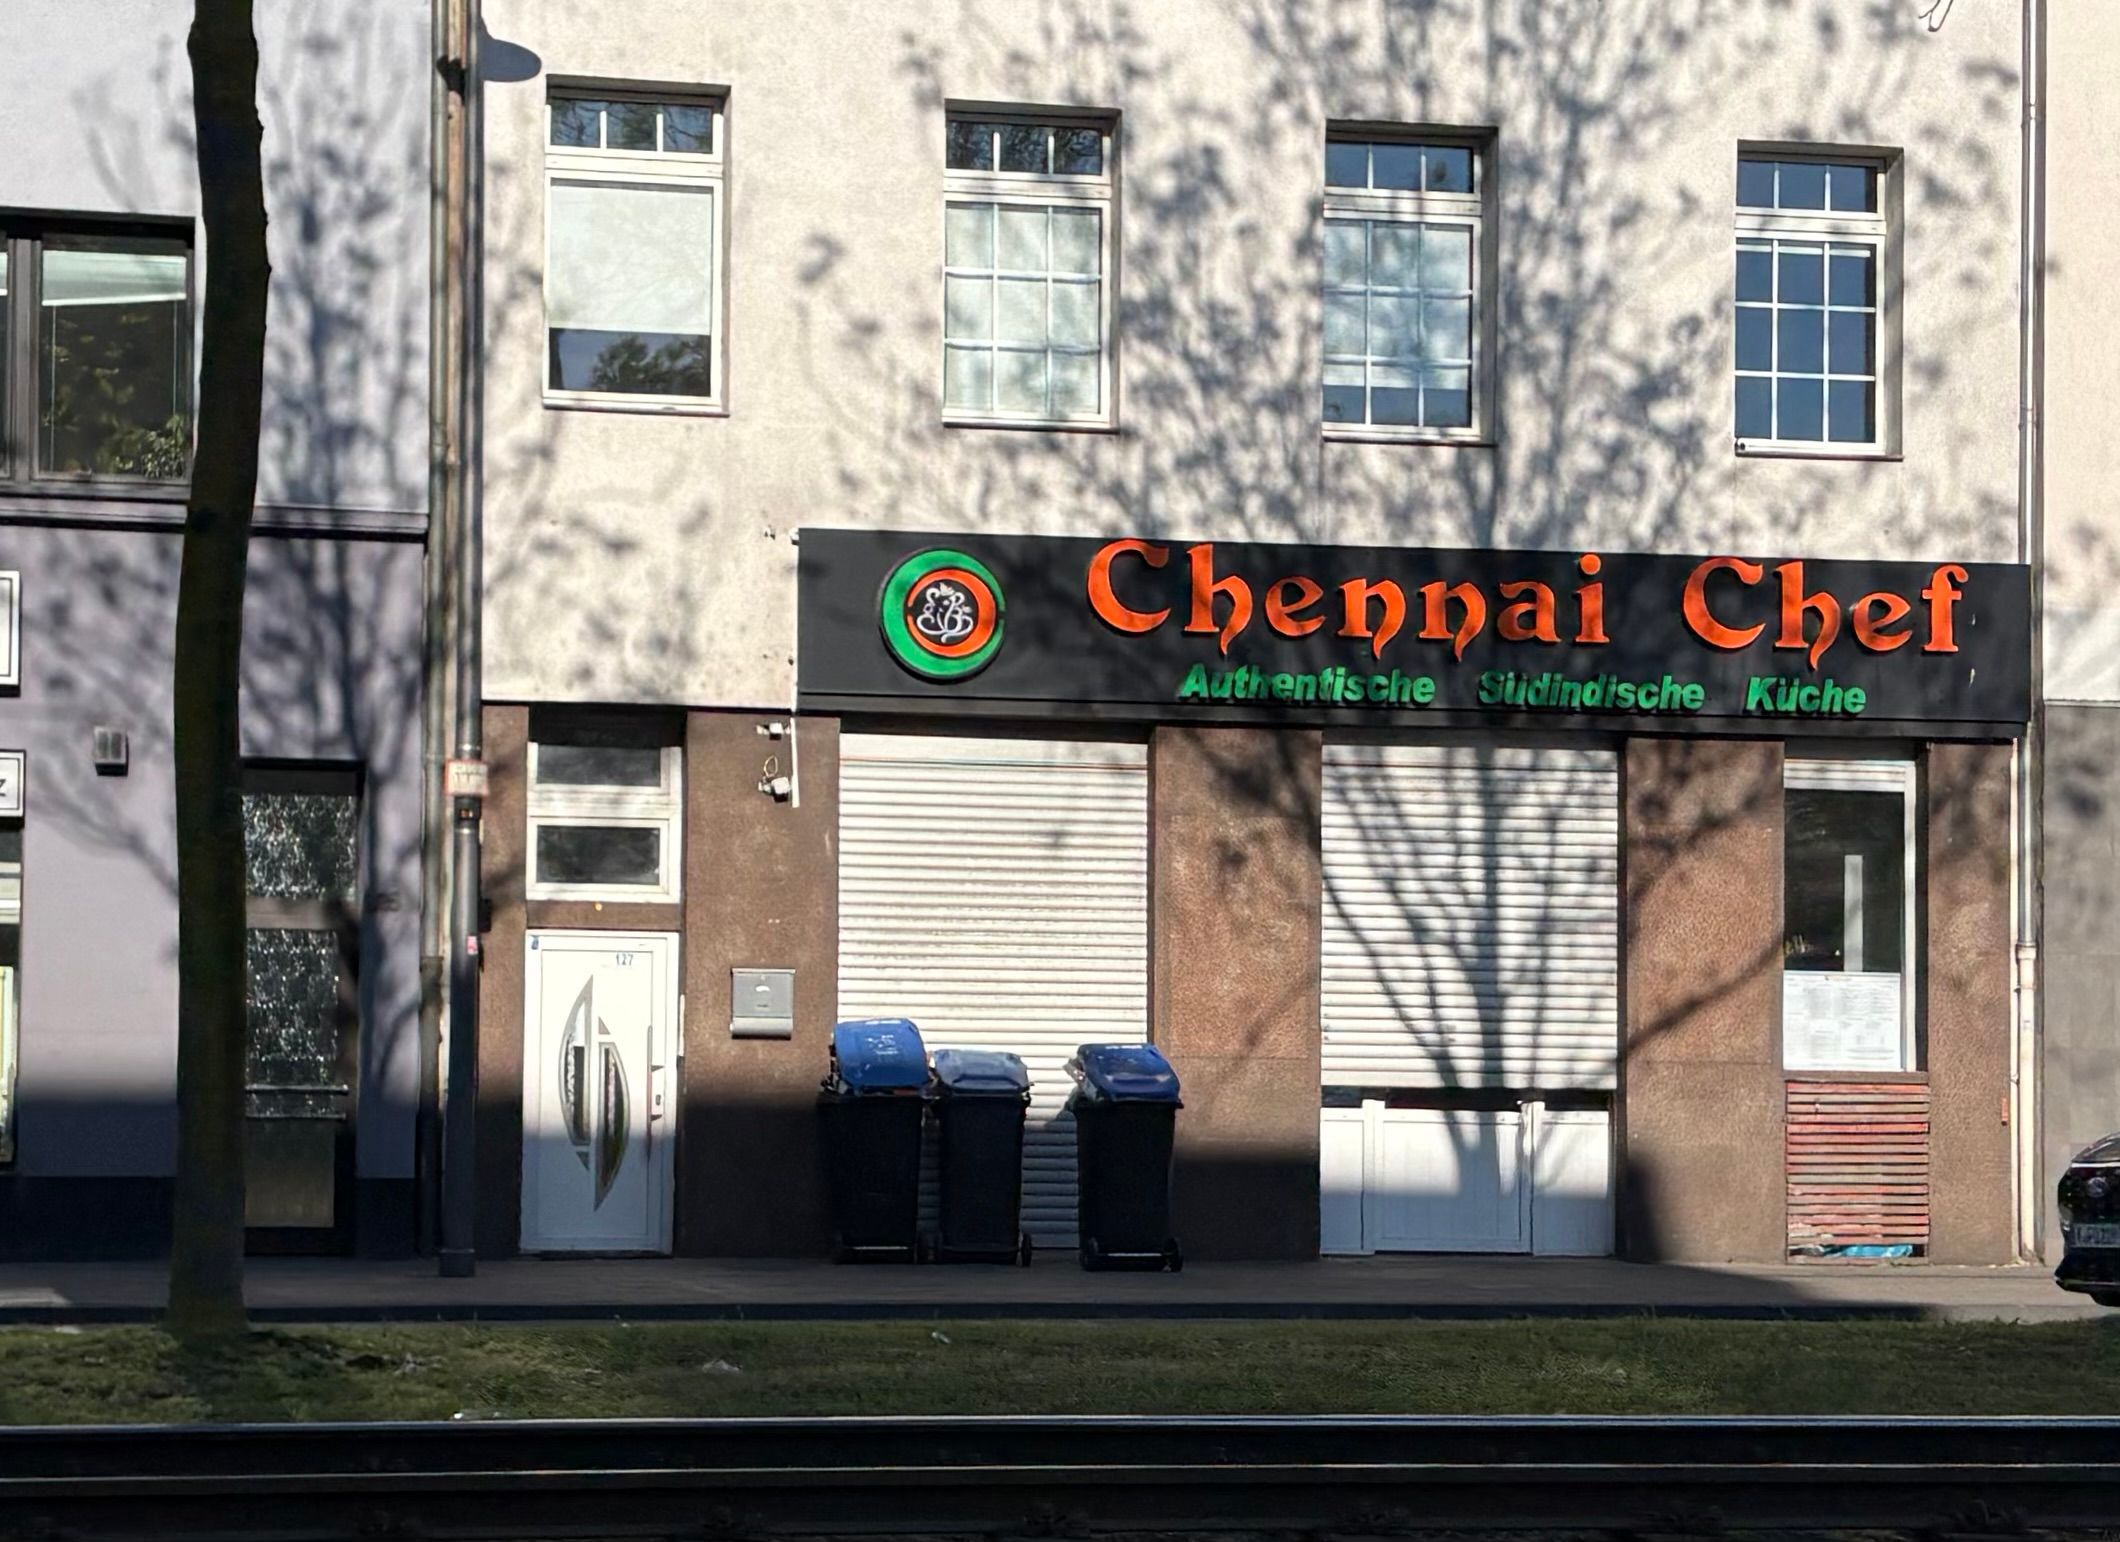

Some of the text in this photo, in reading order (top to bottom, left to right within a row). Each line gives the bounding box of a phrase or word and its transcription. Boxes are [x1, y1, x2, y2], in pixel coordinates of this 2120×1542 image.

[1088, 537, 1968, 668] Chennai Chef
[1179, 663, 1868, 715] Authentische Südindische Küche
